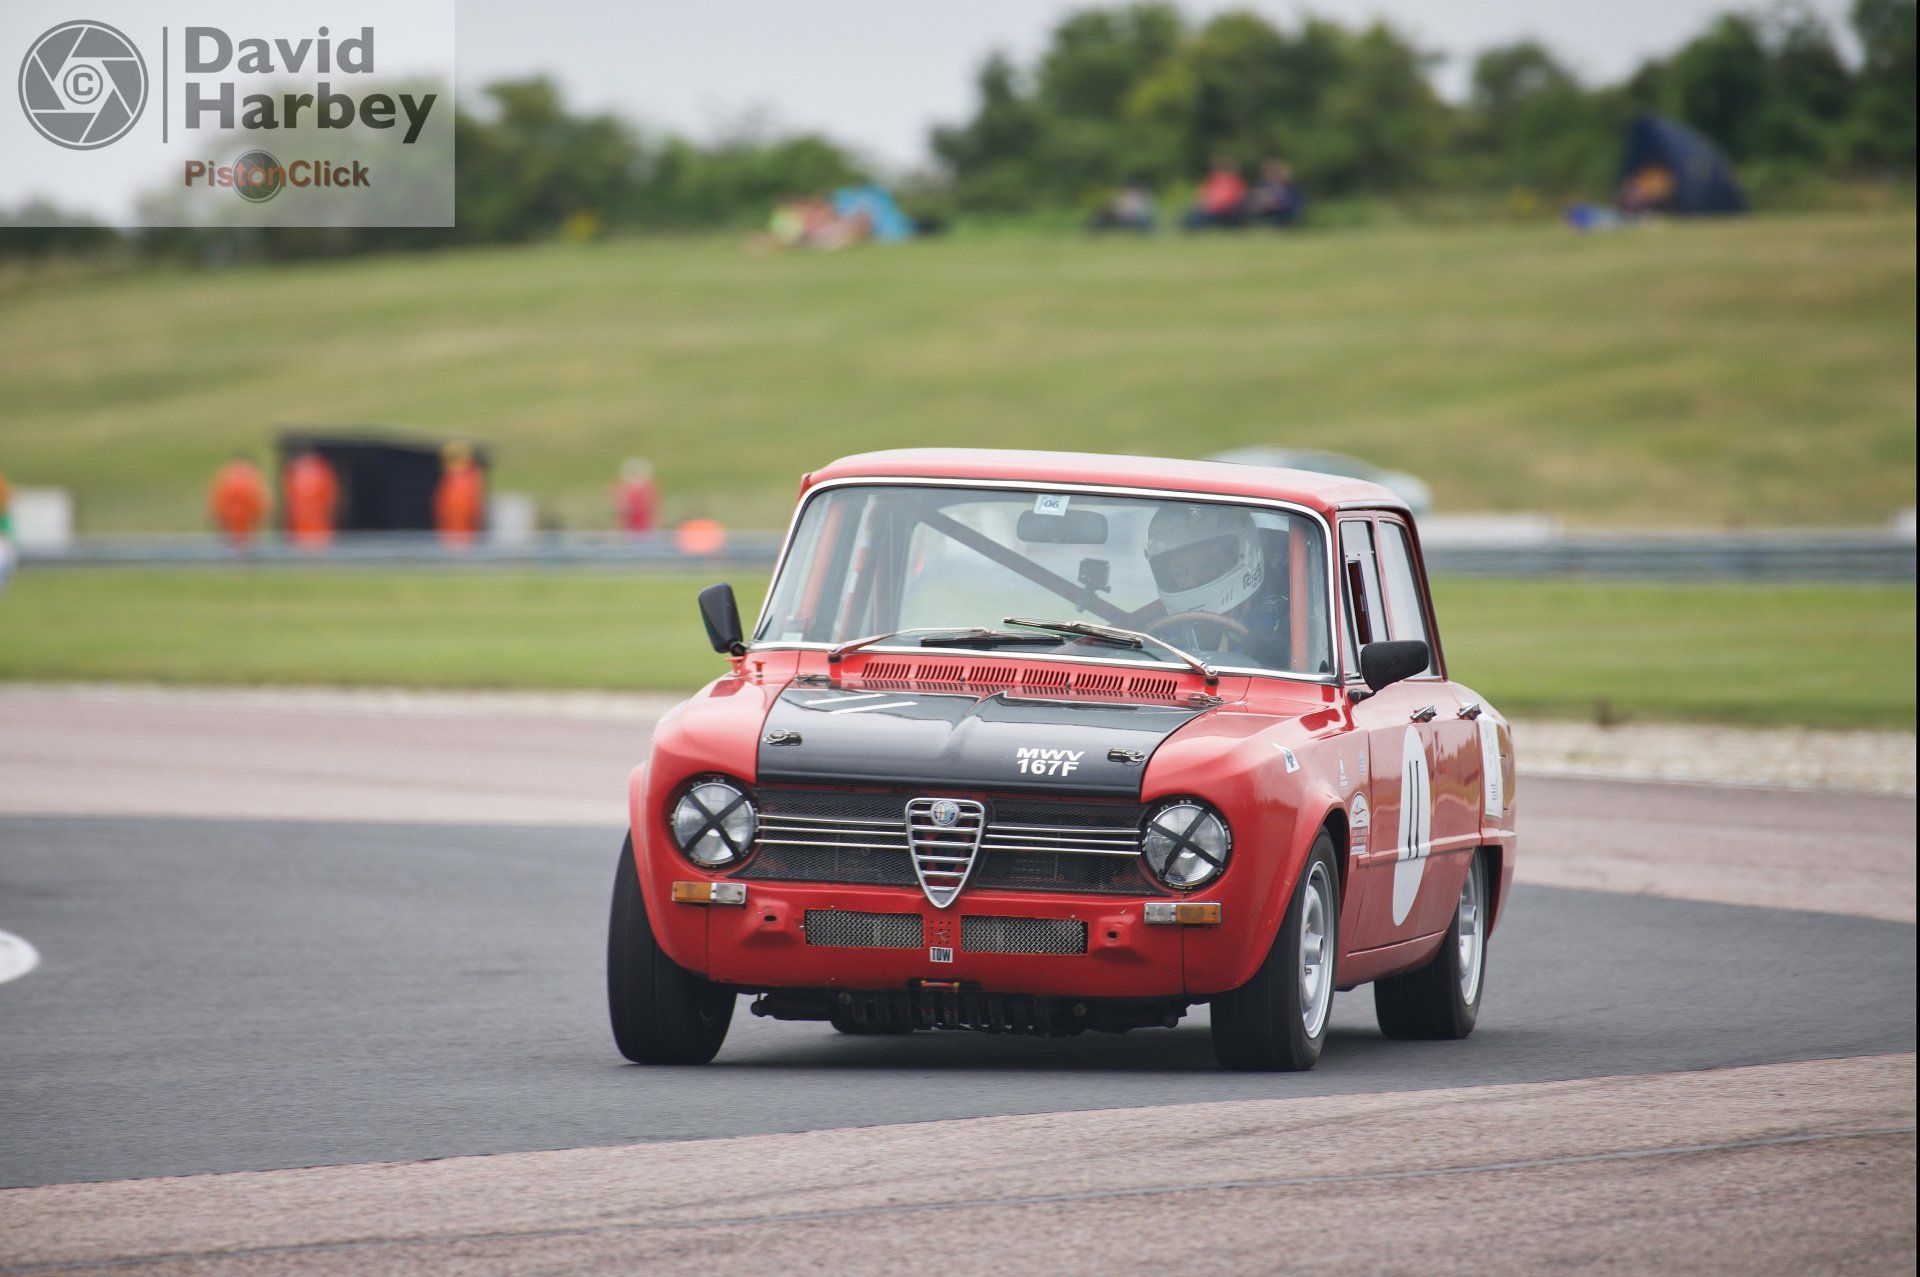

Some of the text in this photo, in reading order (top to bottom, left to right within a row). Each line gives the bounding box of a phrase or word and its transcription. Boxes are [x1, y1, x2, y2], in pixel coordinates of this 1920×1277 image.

[1045, 500, 1060, 508] 06
[1016, 747, 1086, 761] MWV
[1017, 759, 1080, 776] 167F
[1408, 760, 1419, 858] 11
[932, 948, 951, 961] TOW
